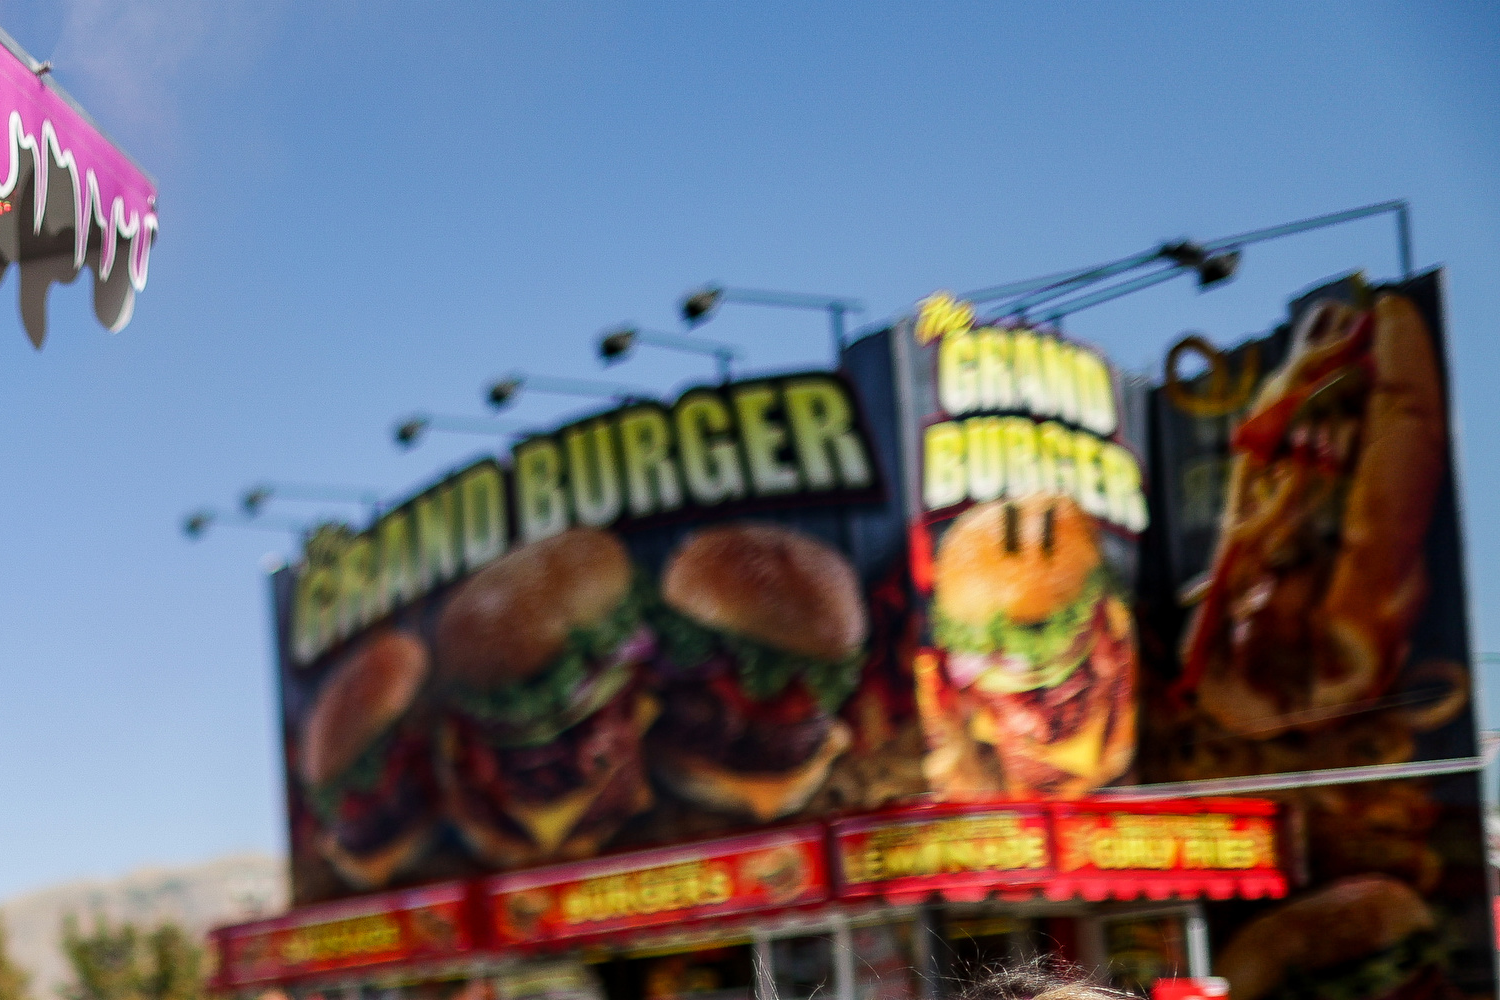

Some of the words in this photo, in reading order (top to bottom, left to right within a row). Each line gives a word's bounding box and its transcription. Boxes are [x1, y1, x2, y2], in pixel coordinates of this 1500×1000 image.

[938, 325, 1118, 437] GRAND
[517, 380, 874, 544] BURGER
[923, 415, 1149, 534] BURGER
[563, 868, 732, 925] BURGERS
